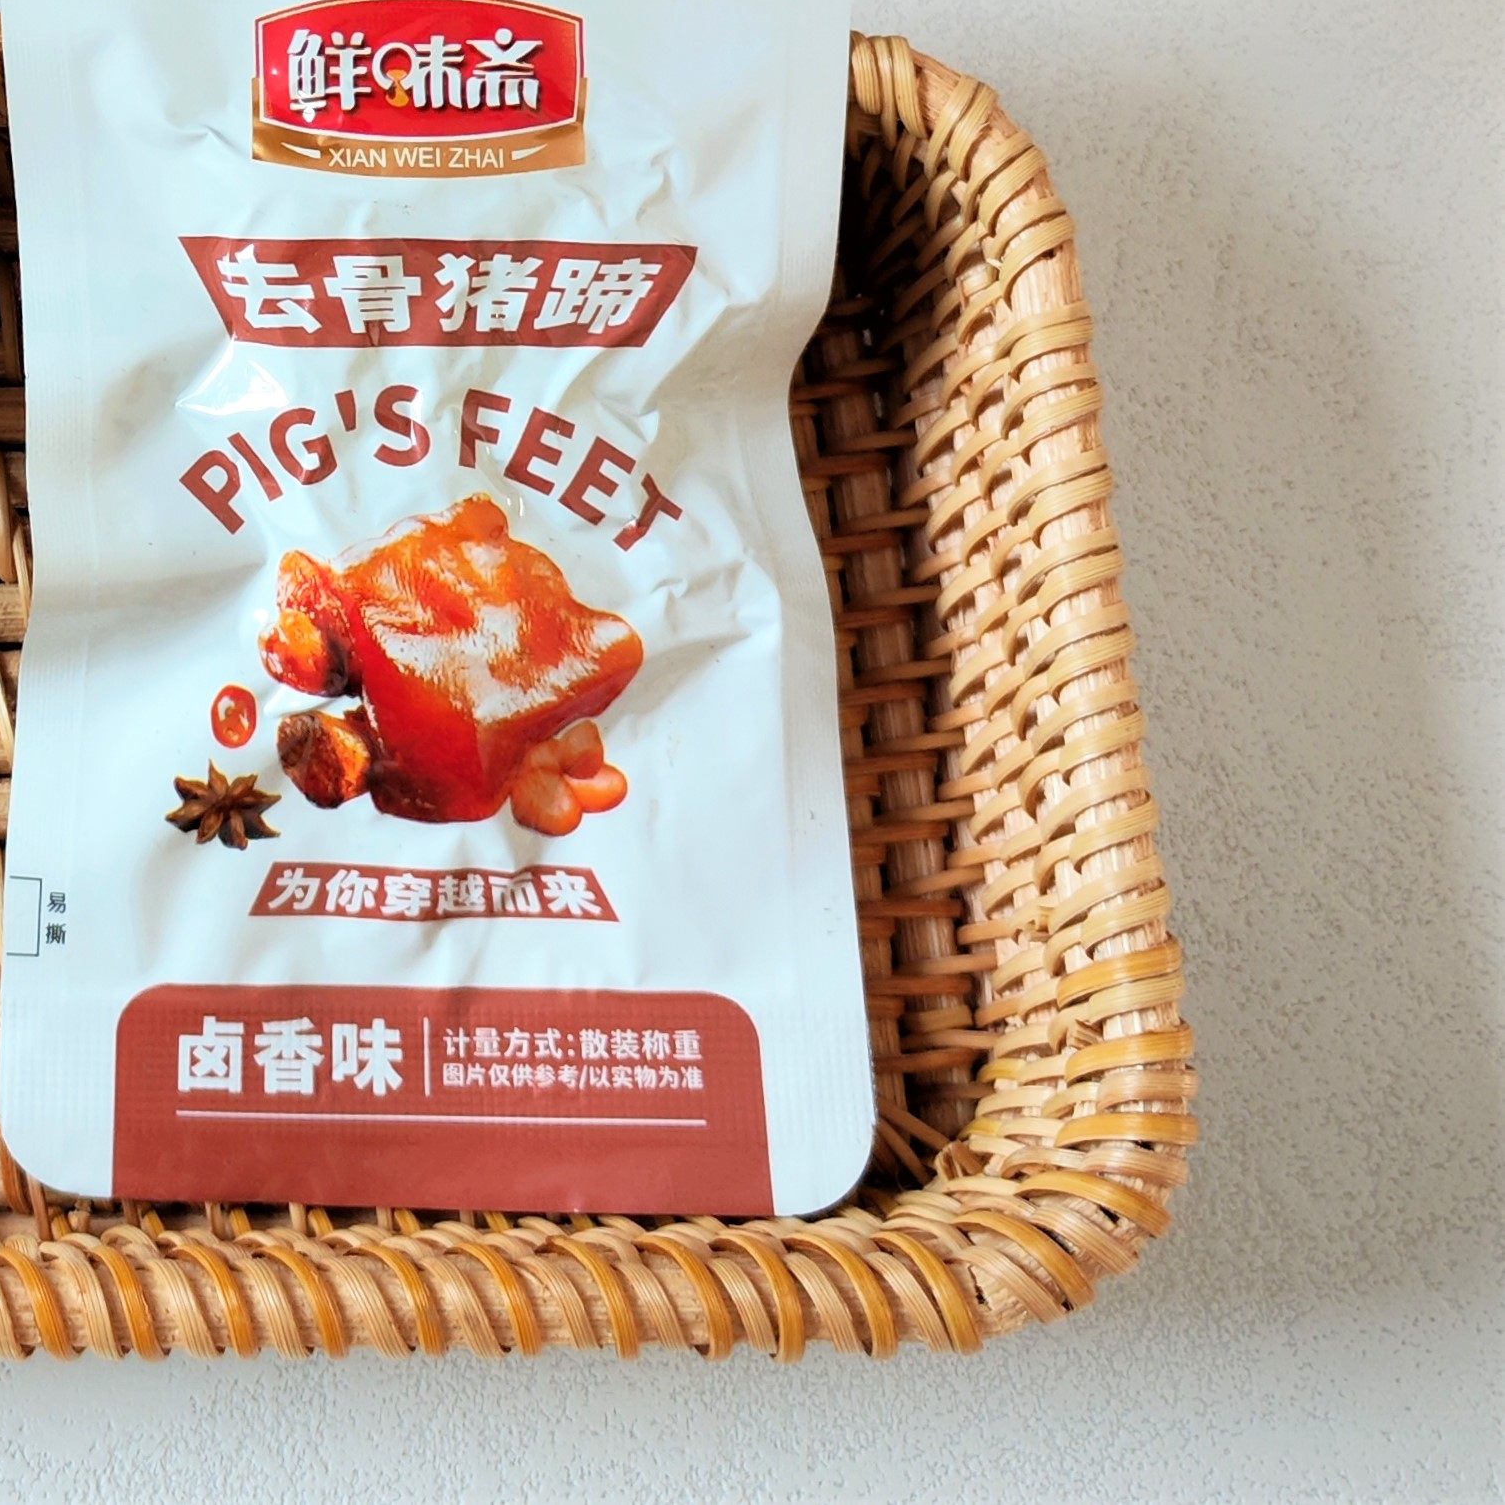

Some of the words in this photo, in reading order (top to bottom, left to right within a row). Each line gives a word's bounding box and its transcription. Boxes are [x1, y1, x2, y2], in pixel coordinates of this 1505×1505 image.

[288, 27, 545, 116] 鲜味斋
[328, 146, 388, 170] XIAN
[393, 146, 443, 170] WEI
[448, 146, 506, 170] ZHAI
[217, 244, 664, 337] 去骨猪蹄
[179, 385, 432, 535] PIG'S
[458, 388, 683, 553] FEET
[45, 891, 68, 947] 易撕
[268, 868, 603, 917] 为你穿越而来
[176, 1015, 405, 1096] 卤香味
[442, 1062, 704, 1091] 图片仅供参考/以实物为准
